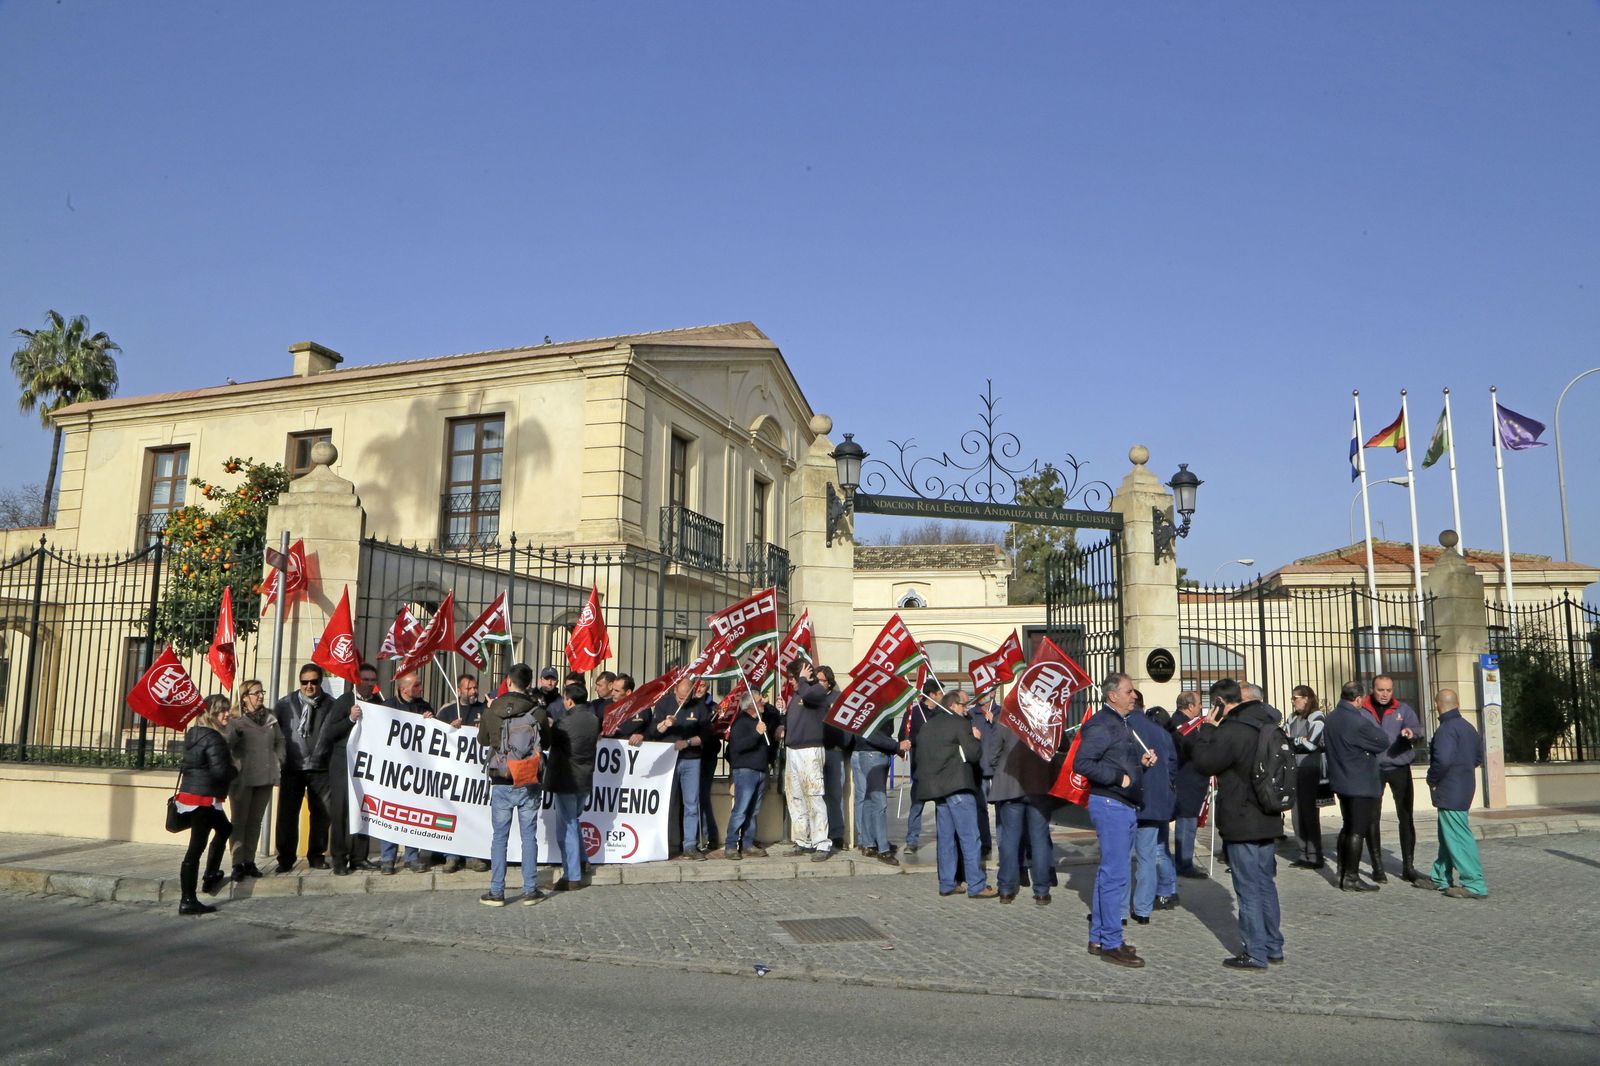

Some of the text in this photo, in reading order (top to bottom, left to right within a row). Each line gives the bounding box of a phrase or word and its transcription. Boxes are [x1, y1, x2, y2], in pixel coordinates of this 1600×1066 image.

[150, 666, 185, 699] UGT
[386, 718, 490, 766] POR EL PAG
[598, 747, 639, 774] OS Y
[352, 750, 375, 782] EL
[379, 759, 492, 806] INCUMPLIM
[360, 816, 392, 830] servicios
[400, 826, 408, 834] la
[384, 804, 434, 826] CCOO
[606, 830, 626, 842] FSP
